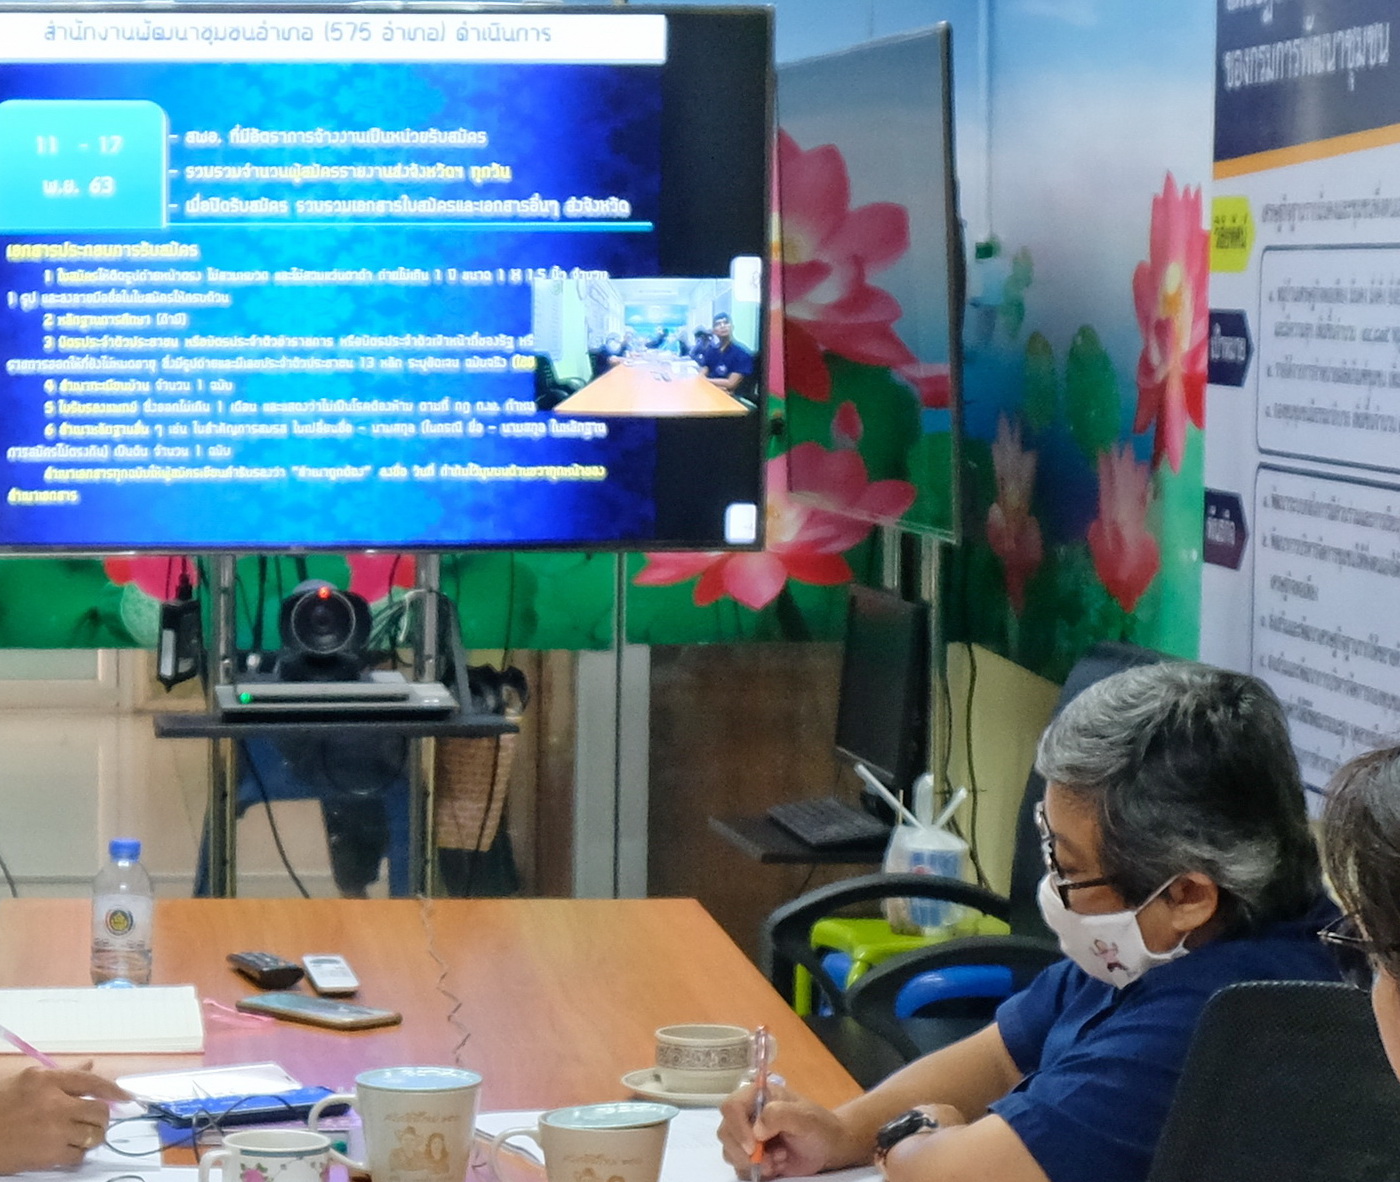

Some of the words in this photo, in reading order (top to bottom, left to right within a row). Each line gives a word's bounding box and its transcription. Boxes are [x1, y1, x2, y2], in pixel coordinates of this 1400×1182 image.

[43, 19, 314, 46] สำนักงานพัฒนาชุมชนอำเภอ
[324, 21, 372, 43] (575
[382, 20, 446, 43] อำเภอ)
[455, 20, 552, 43] ดำเนินการ
